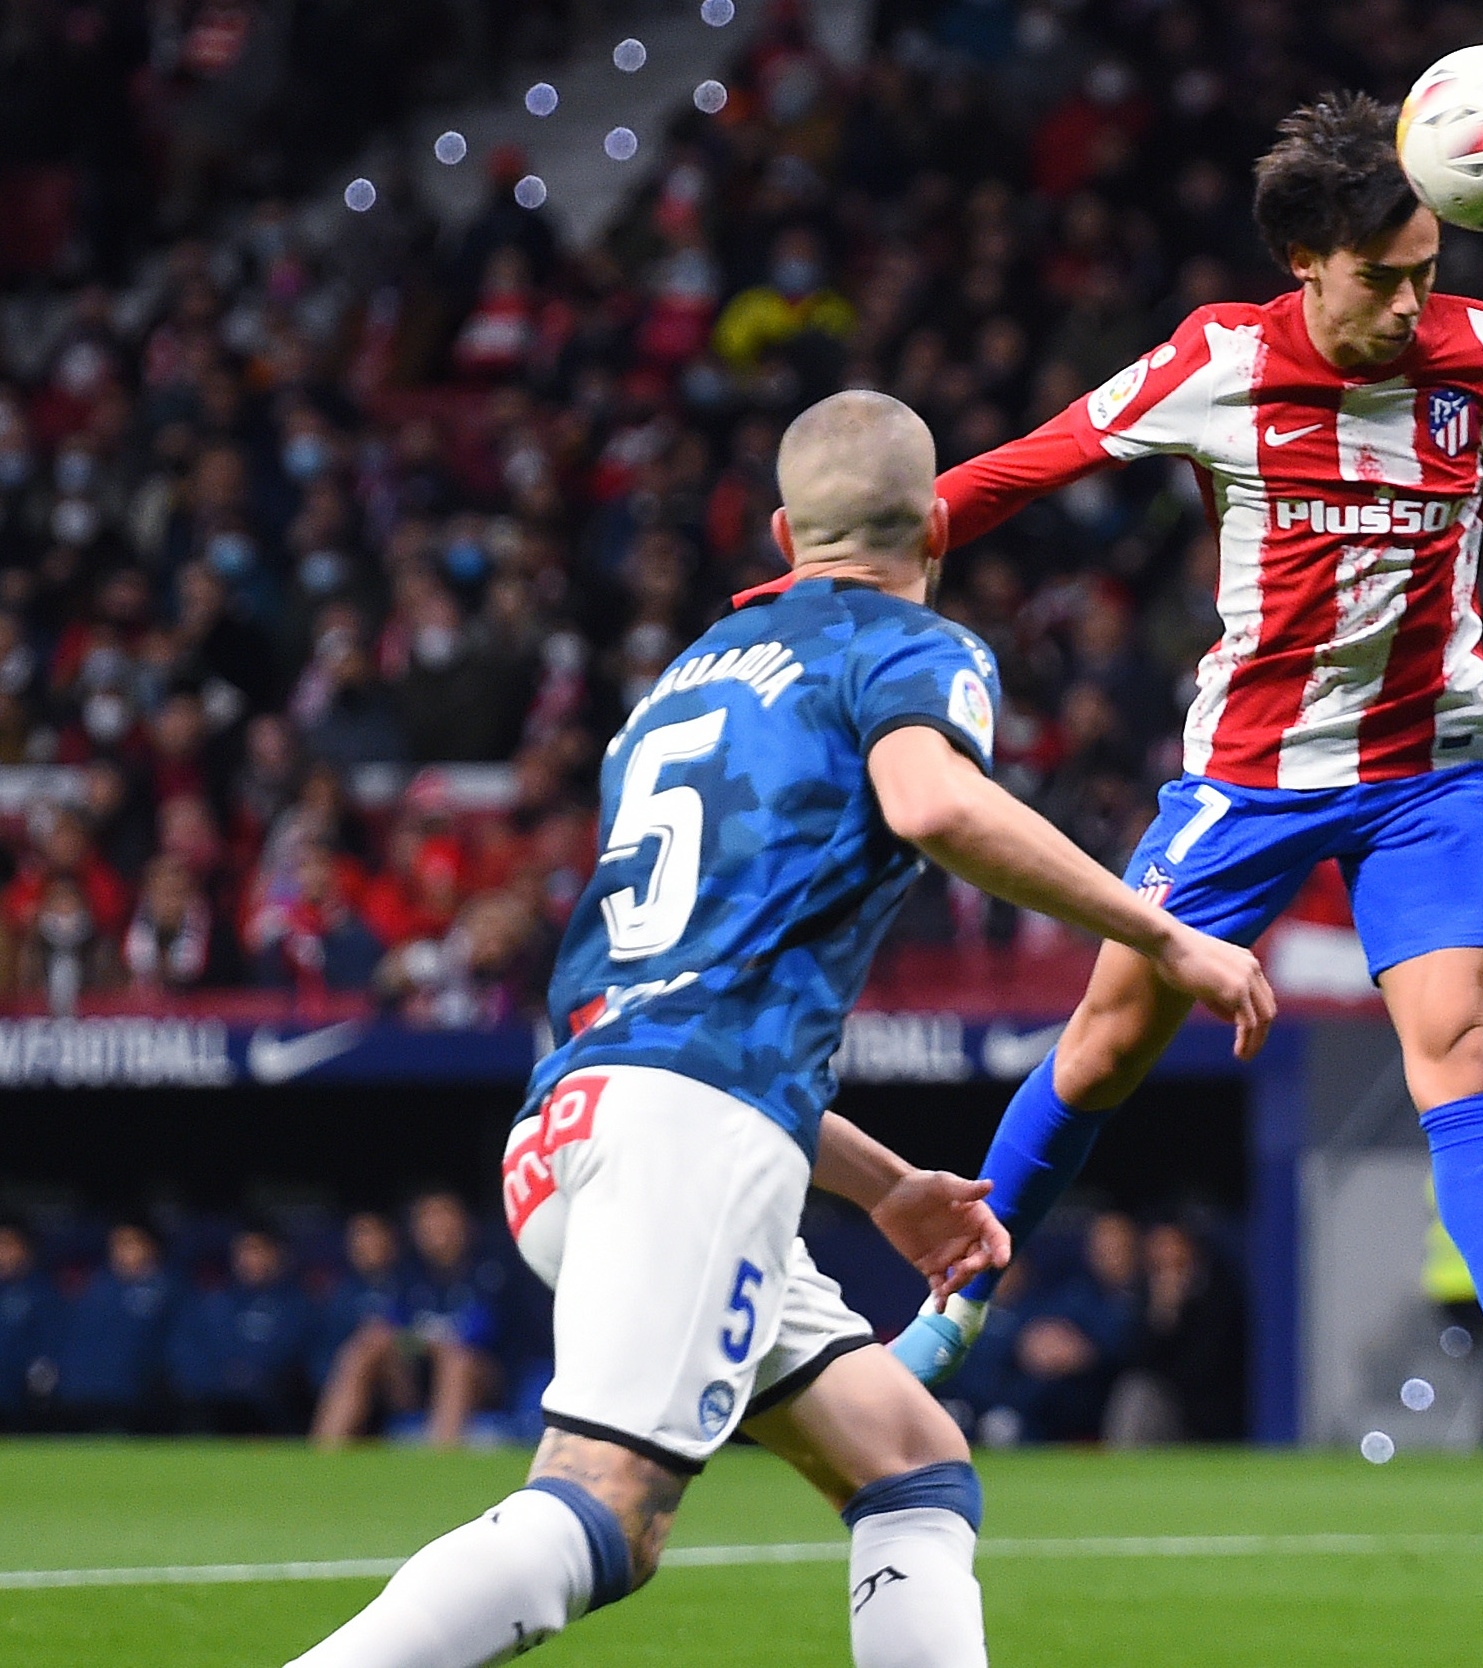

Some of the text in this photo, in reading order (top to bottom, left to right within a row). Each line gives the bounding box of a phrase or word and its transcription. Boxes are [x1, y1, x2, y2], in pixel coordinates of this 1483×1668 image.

[1276, 496, 1474, 535] Plus50
[599, 706, 728, 961] 5
[1165, 784, 1232, 865] 7
[719, 1258, 764, 1364] 5
